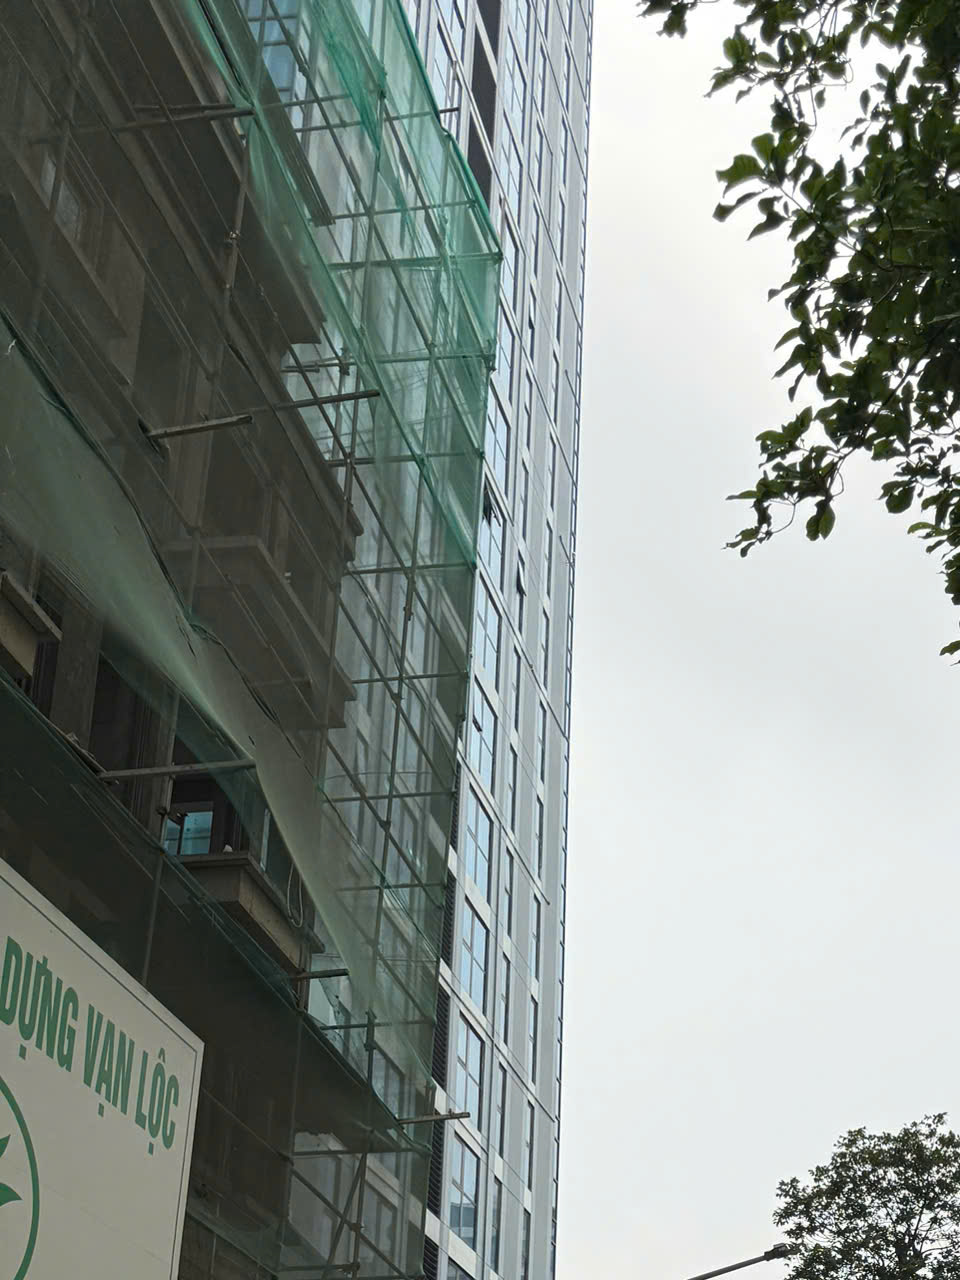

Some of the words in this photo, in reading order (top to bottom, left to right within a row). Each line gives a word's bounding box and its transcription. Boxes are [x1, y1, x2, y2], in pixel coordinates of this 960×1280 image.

[0, 936, 79, 1072] DỰNG
[83, 1003, 135, 1117] VẠN
[135, 1047, 179, 1155] LỘC
